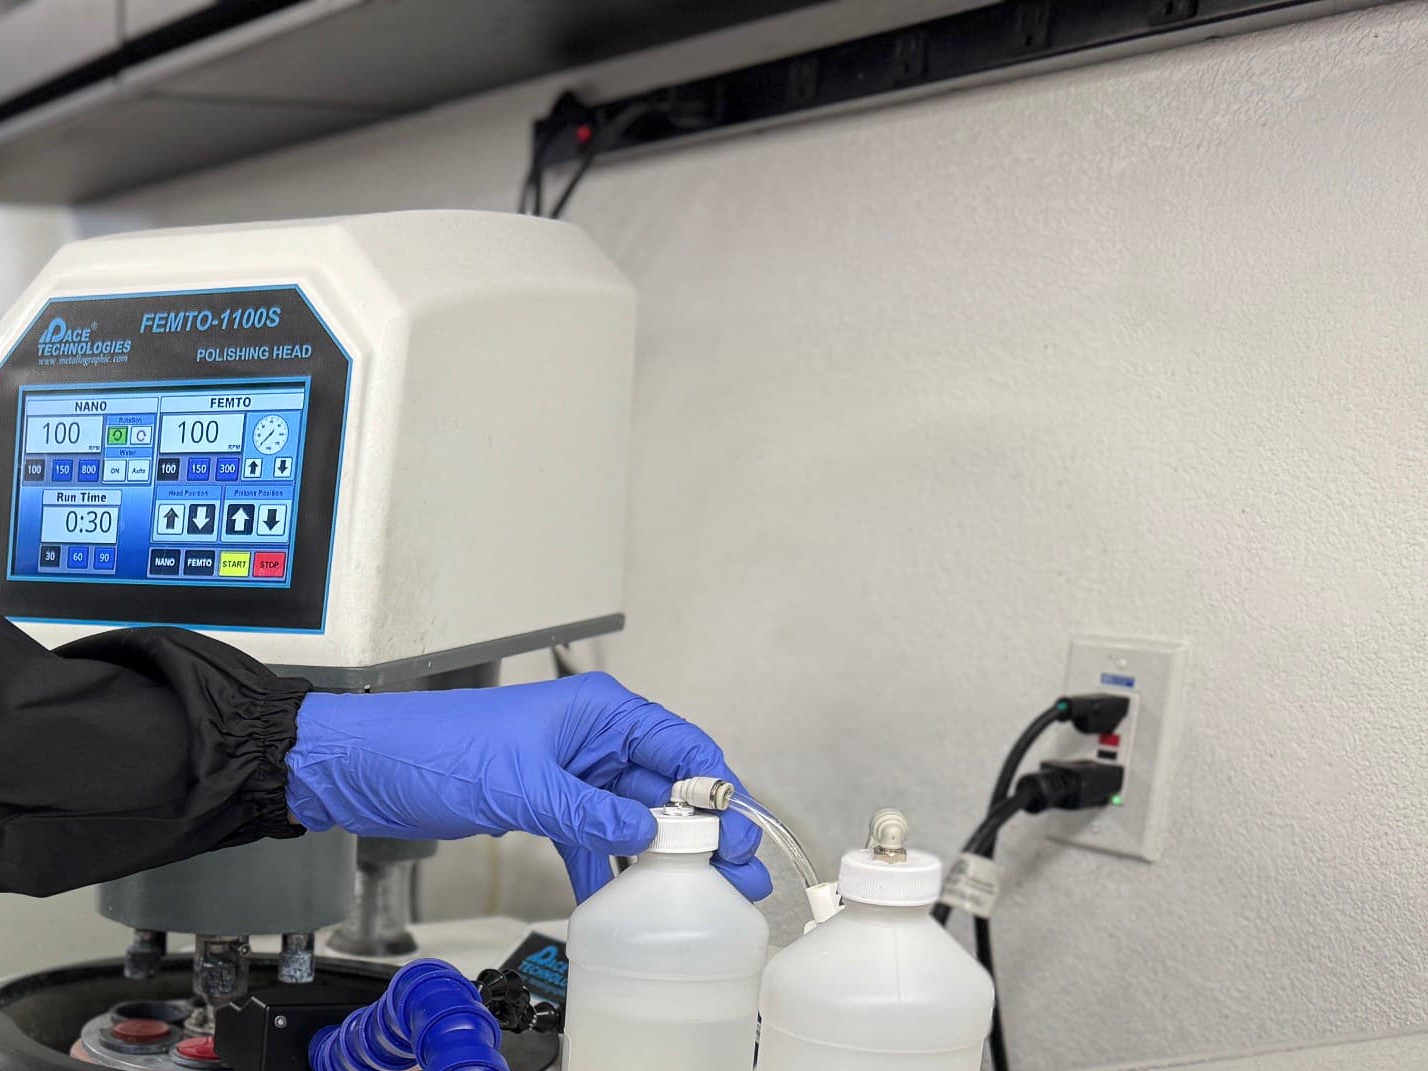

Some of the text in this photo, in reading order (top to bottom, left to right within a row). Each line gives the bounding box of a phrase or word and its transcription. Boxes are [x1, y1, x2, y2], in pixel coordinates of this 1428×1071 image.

[139, 305, 282, 334] FEMTO-1100S
[38, 317, 91, 342] PACE
[37, 340, 132, 356] TECHNOLOGIES
[196, 345, 312, 362] POLISHING HEAD
[74, 401, 107, 412] NANO
[210, 397, 252, 408] FEMTO
[43, 421, 80, 445] 100
[178, 420, 219, 444] 100
[27, 465, 42, 475] 100
[56, 465, 70, 475] 150
[161, 464, 176, 474] 100
[192, 464, 207, 474] 150
[219, 464, 236, 473] 300
[56, 492, 107, 503] Run Time
[65, 510, 112, 534] 0:30
[45, 551, 56, 561] 30
[72, 553, 83, 562] 60
[99, 553, 110, 562] 90
[155, 557, 175, 567] NANO
[187, 557, 213, 567] FEMTO
[222, 560, 247, 569] START
[259, 561, 280, 569] STOP
